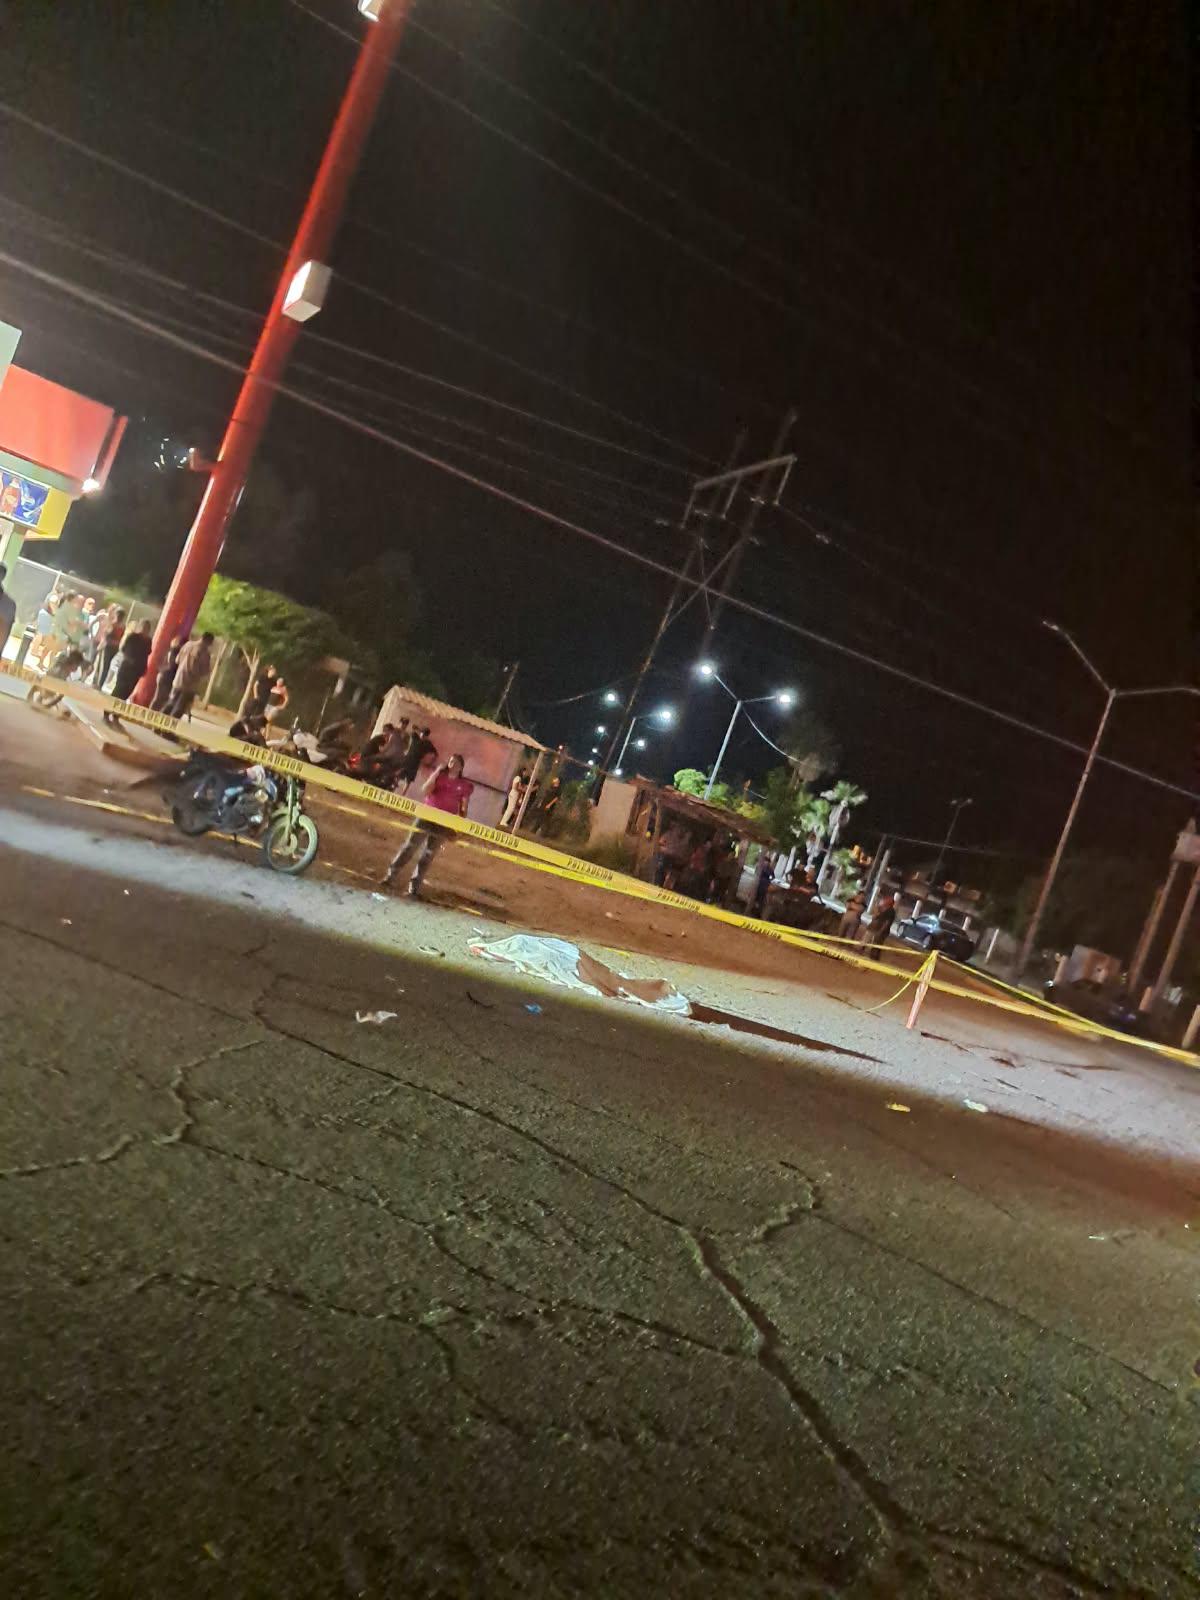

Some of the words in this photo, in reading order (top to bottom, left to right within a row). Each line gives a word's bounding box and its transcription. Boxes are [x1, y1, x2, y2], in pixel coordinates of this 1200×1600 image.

[113, 699, 178, 729] PRECAUCION
[242, 744, 304, 773] PRECAUCION
[362, 785, 417, 813] PRECAUCION
[469, 822, 520, 849] PRECAUCION
